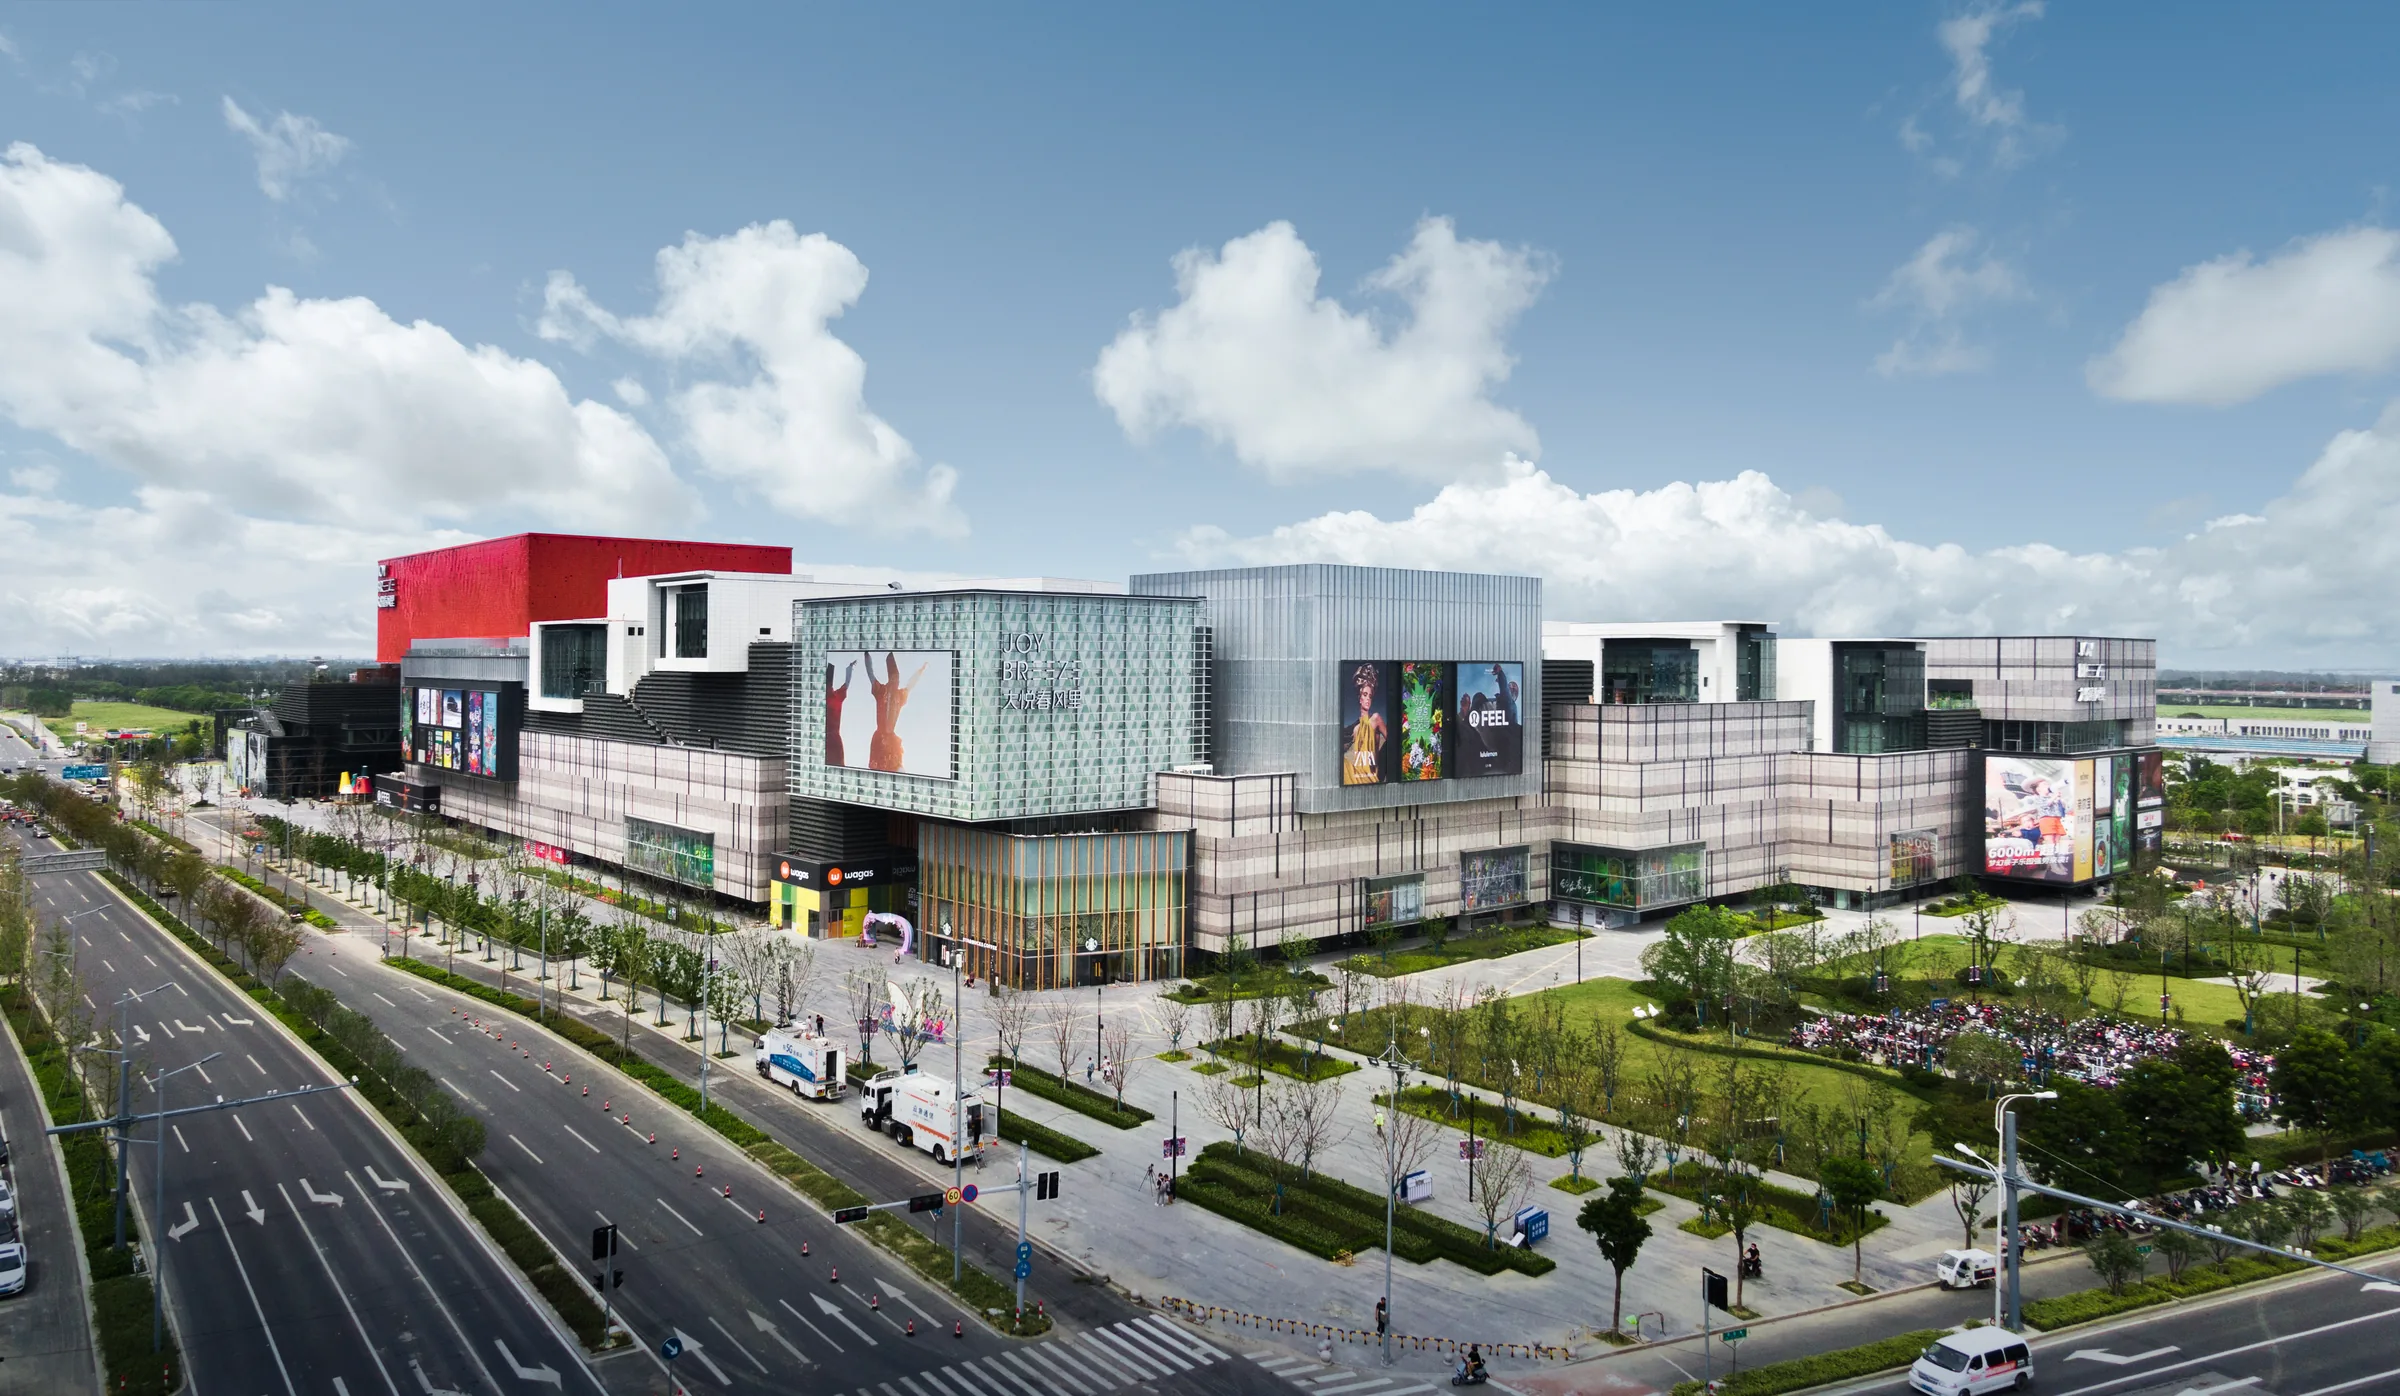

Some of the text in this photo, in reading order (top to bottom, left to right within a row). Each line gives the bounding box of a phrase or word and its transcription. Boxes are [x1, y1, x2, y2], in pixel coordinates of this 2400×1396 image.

[1002, 633, 1044, 653] JOY
[1002, 661, 1082, 680] BREEZE
[1002, 690, 1082, 710] 大悦春风里
[1481, 710, 1509, 727] FEEL
[790, 868, 809, 880] wagas
[844, 869, 874, 880] wagas
[949, 1191, 959, 1200] 60
